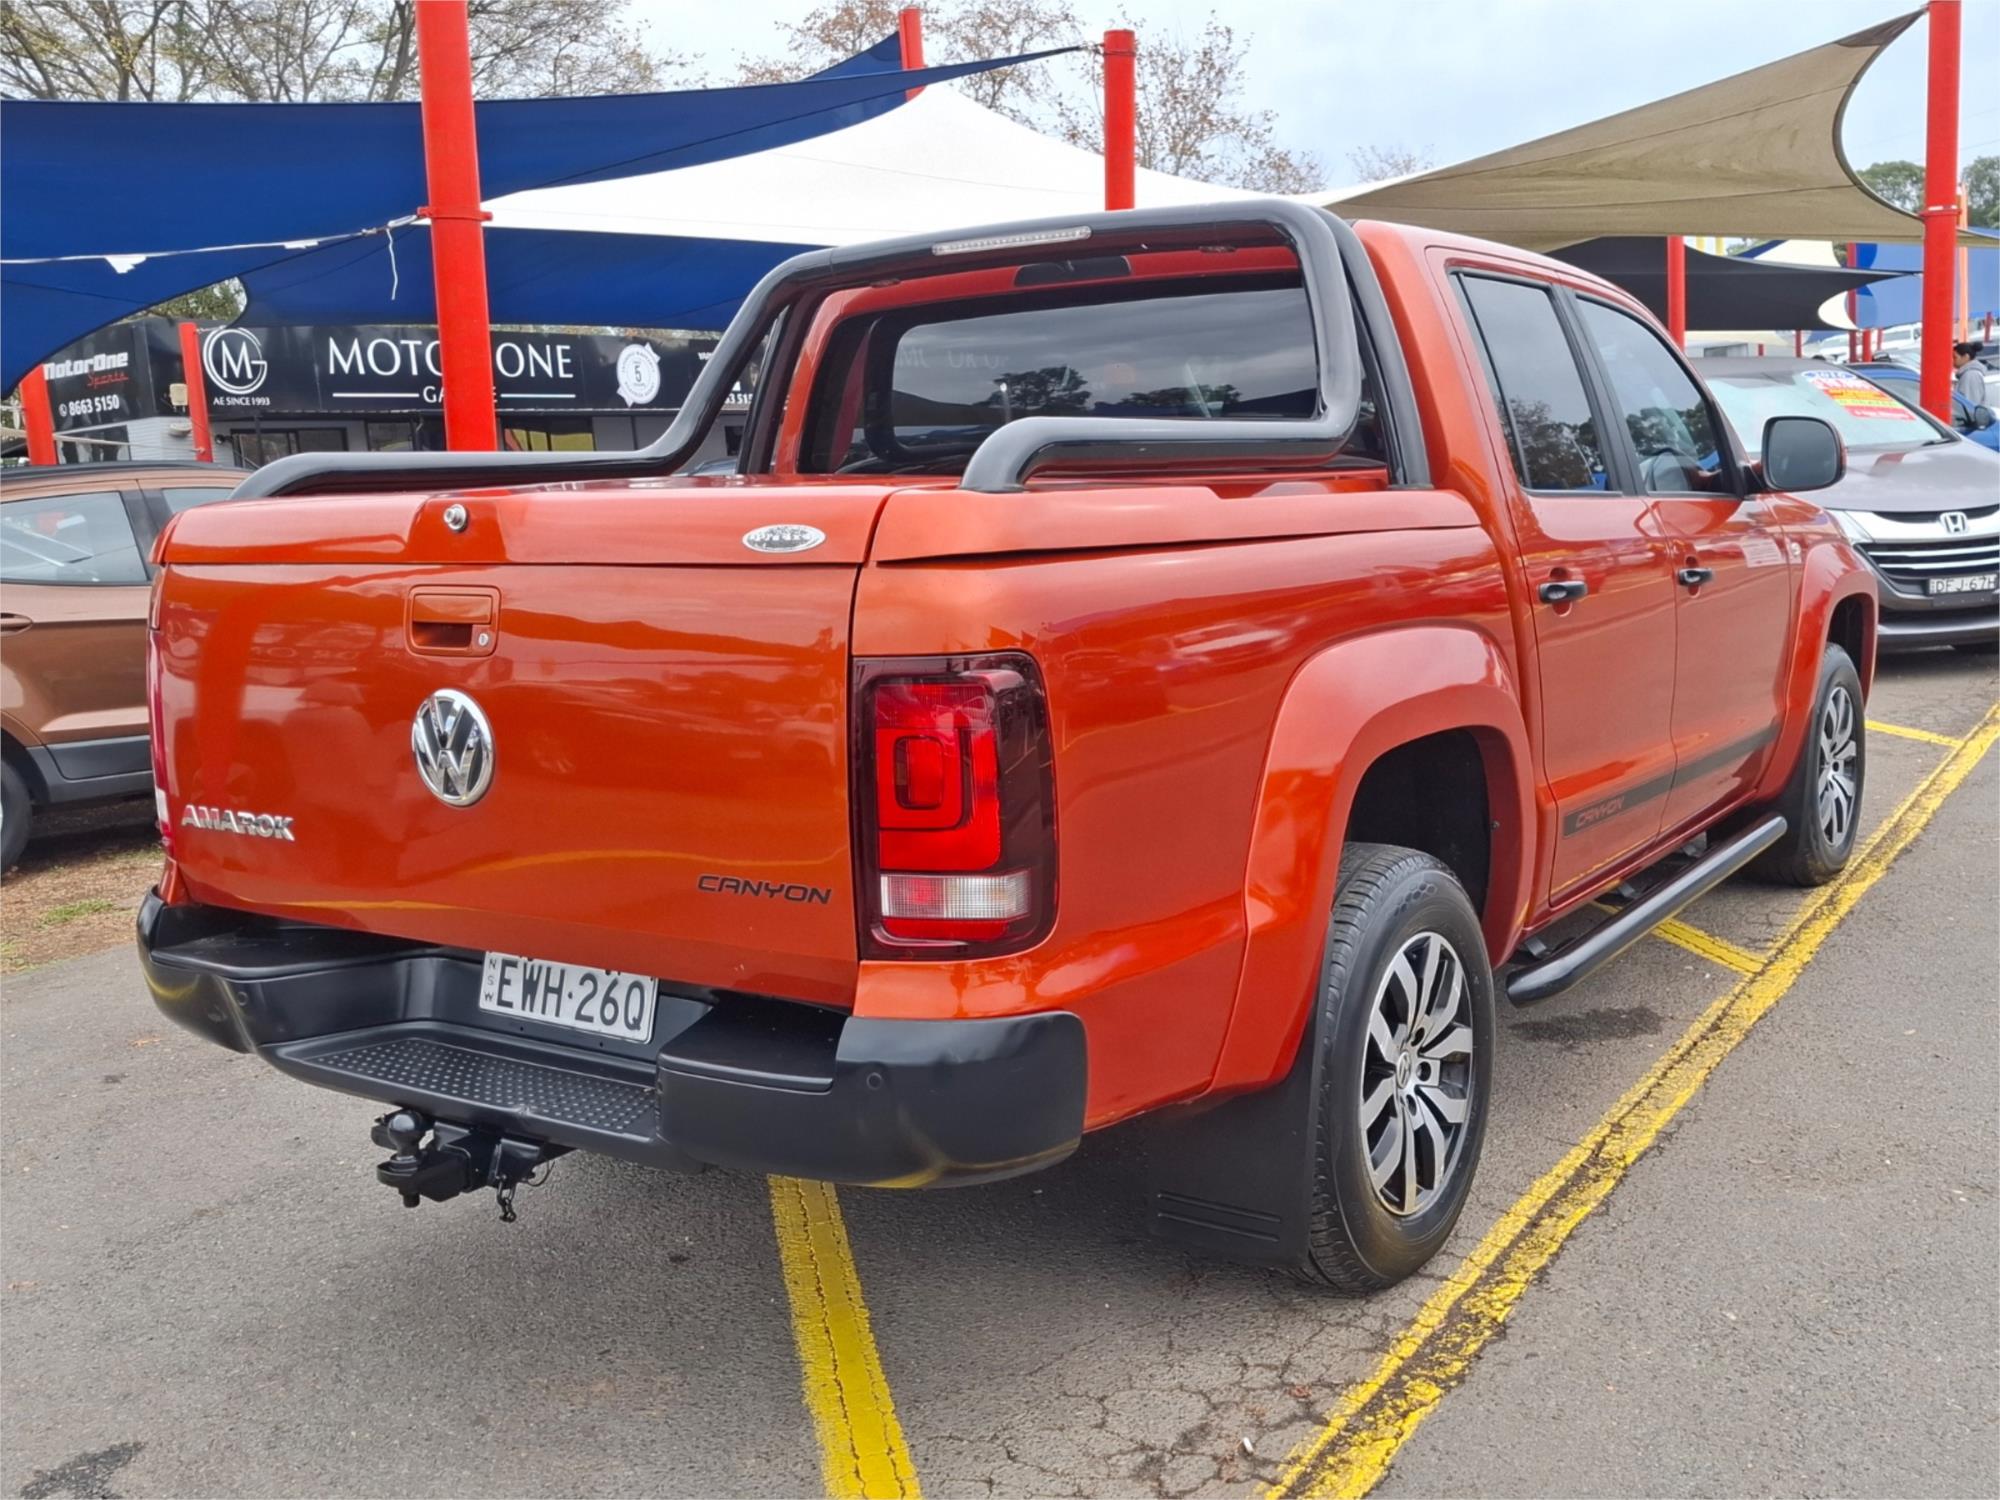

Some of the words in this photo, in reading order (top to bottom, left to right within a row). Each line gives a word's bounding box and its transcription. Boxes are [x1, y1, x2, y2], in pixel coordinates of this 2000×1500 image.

[68, 399, 93, 417] 8663
[94, 394, 120, 413] 5150
[225, 396, 250, 406] SINCE
[250, 396, 271, 406] 1993
[181, 804, 295, 842] AMAROK
[698, 875, 832, 904] CANYON
